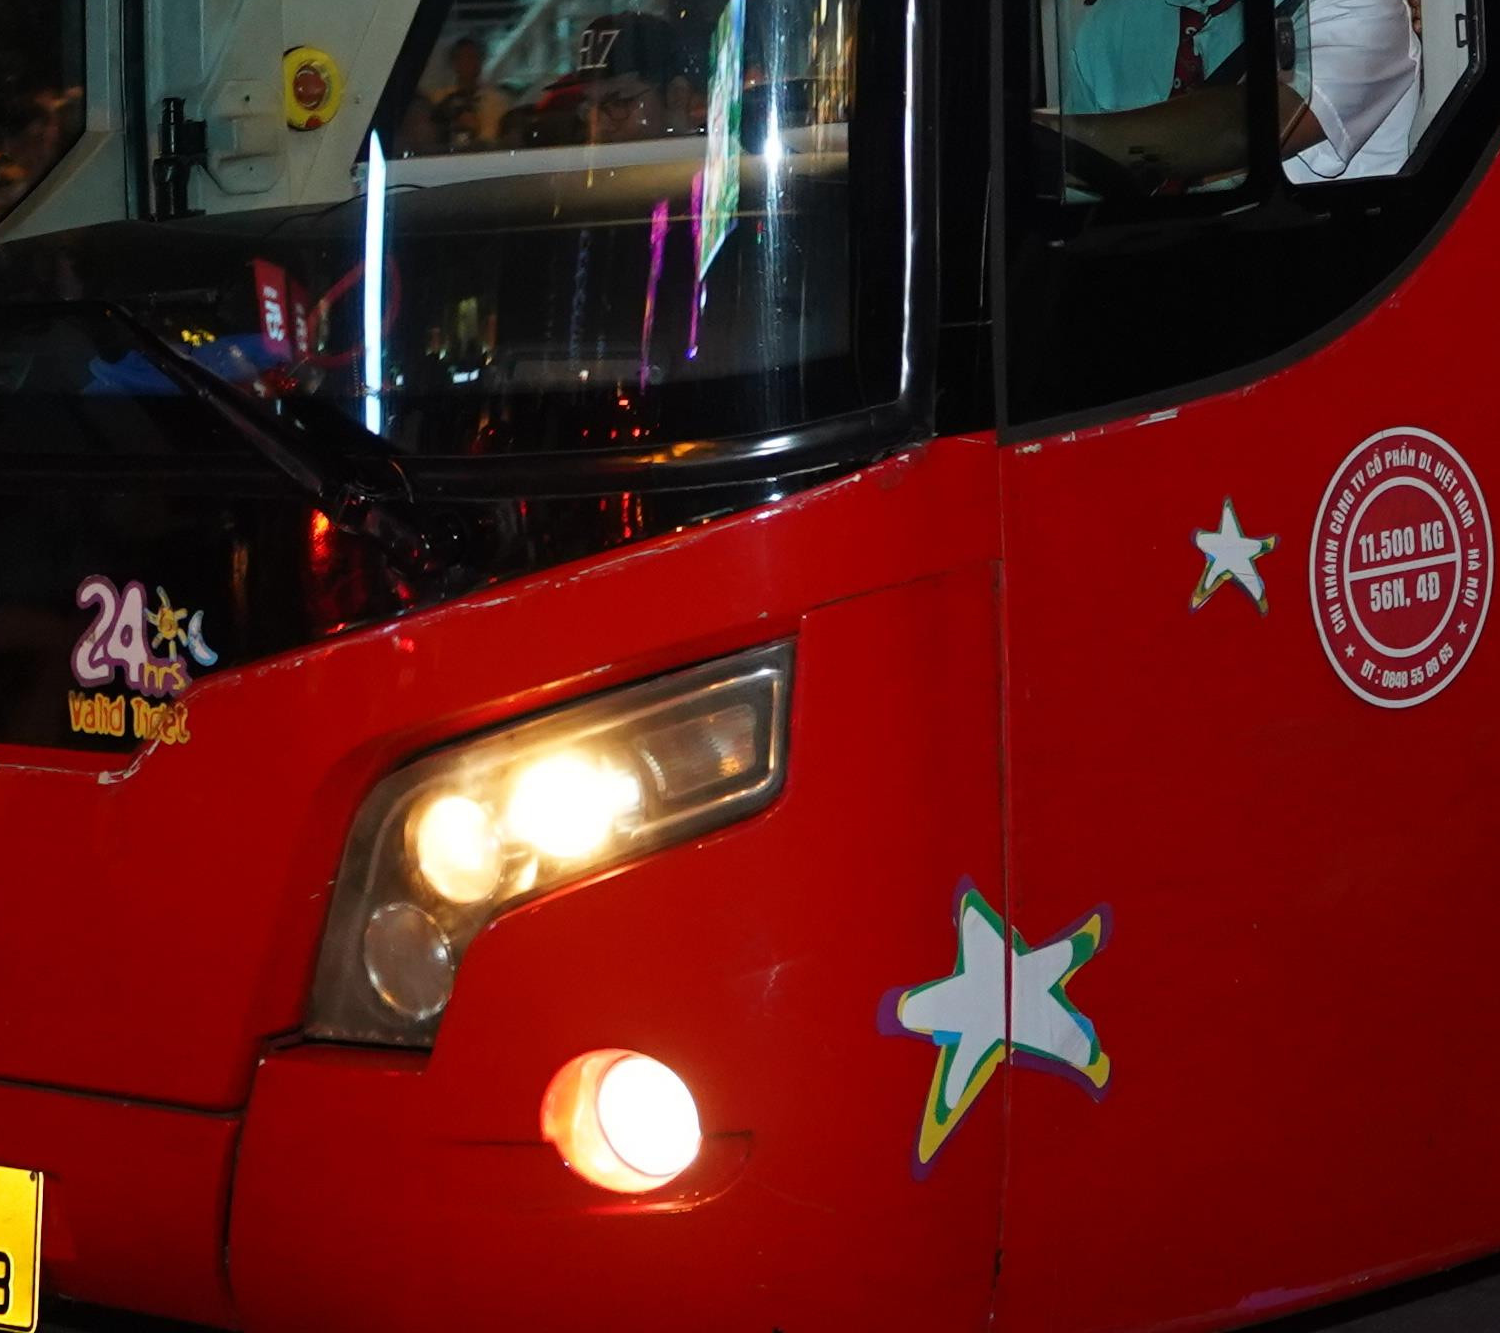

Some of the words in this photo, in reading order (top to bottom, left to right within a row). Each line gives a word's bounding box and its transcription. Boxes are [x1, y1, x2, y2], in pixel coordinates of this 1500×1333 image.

[1366, 448, 1383, 480] CỔ
[1385, 441, 1416, 467] PHẦN
[1418, 451, 1432, 474] DL
[1350, 470, 1366, 493] TY
[1435, 465, 1458, 493] VIỆT
[1329, 489, 1356, 535] CÔNG
[1452, 489, 1476, 530] NAM
[1358, 526, 1415, 564] 11.500
[1420, 520, 1445, 551] KG
[1324, 539, 1339, 599] NHÁNH
[1467, 548, 1482, 571] HÀ
[1369, 578, 1411, 613] 56N,
[1461, 574, 1479, 608] NỘI
[1328, 604, 1347, 634] CHI
[68, 690, 126, 737] Valid
